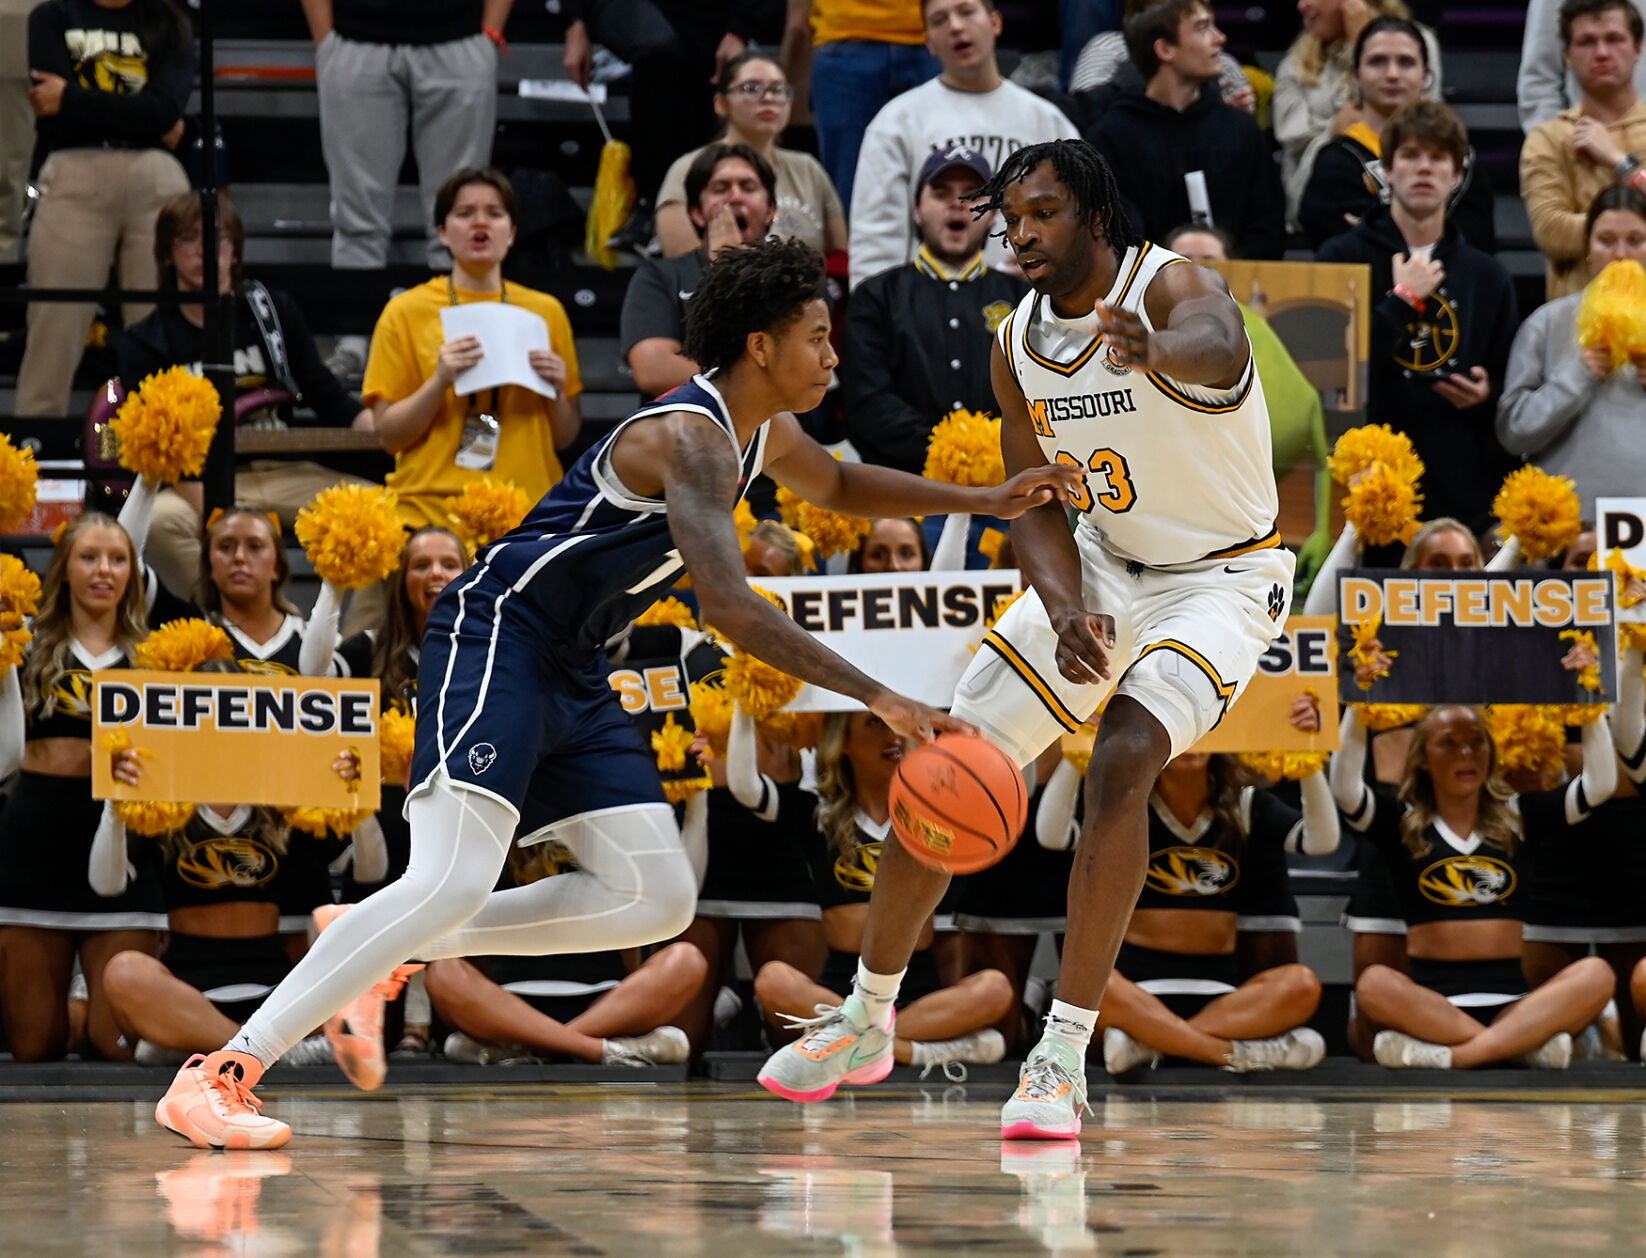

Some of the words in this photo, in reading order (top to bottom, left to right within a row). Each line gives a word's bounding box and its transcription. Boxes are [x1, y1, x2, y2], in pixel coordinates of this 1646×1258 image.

[1026, 388, 1137, 438] MISSOURI
[1055, 447, 1138, 514] 33
[782, 584, 1013, 632] EFENS
[1340, 577, 1611, 627] DEFENSE
[99, 682, 375, 736] DEFENSE
